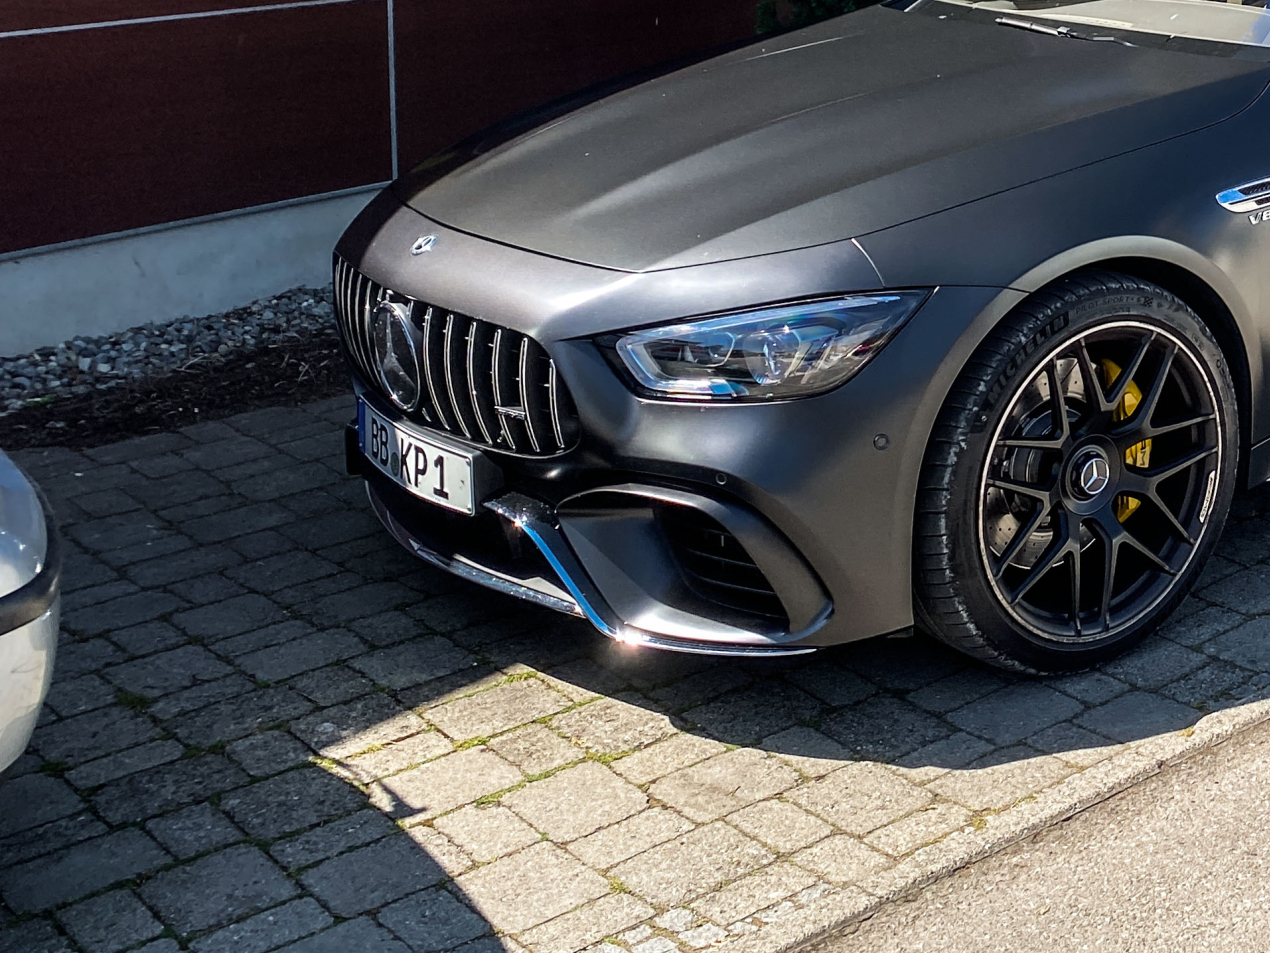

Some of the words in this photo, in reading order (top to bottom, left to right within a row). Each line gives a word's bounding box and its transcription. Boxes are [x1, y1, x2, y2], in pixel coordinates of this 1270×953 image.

[987, 314, 1066, 404] MICHELIN
[371, 416, 389, 467] BB
[400, 437, 428, 488] KP
[433, 455, 449, 500] 1
